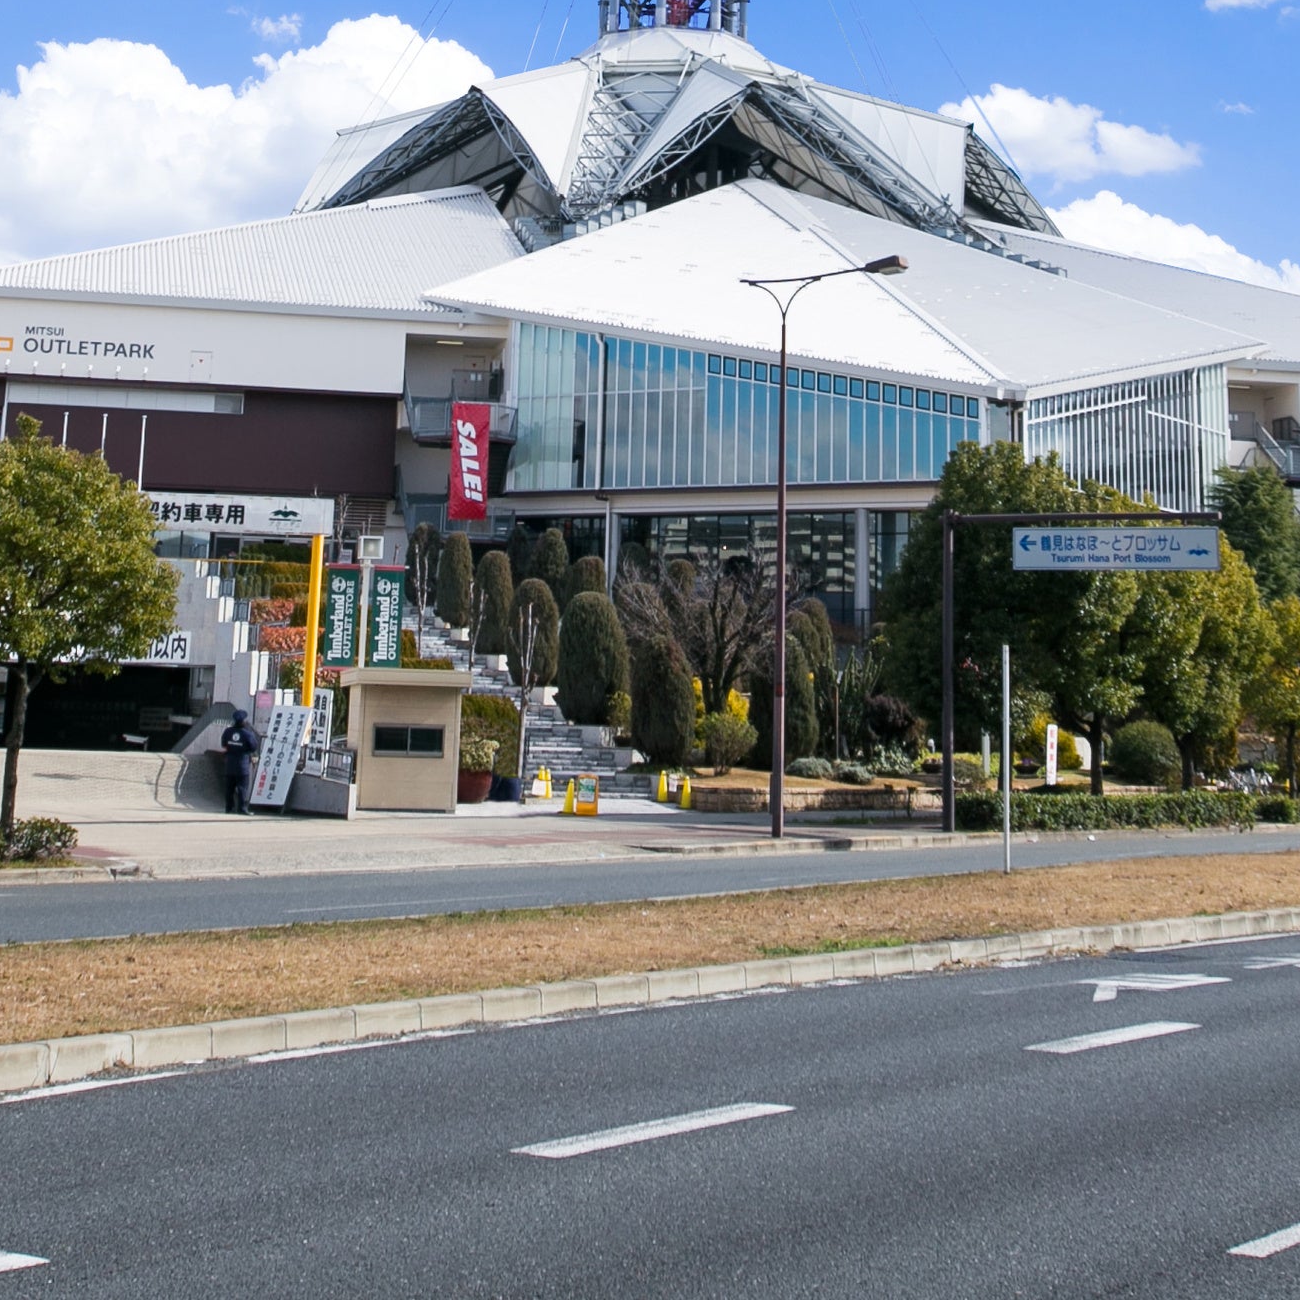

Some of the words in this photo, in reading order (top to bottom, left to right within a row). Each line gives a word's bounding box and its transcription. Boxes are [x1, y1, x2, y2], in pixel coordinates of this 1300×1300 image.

[24, 326, 65, 337] MITSUI
[457, 419, 484, 502] SALE!
[1051, 553, 1086, 563] Tsurumi
[1088, 553, 1110, 563] Hana
[1113, 553, 1132, 563] Port
[1134, 553, 1171, 563] Blossom
[345, 580, 355, 615] STORE
[390, 582, 400, 617] STORE
[327, 594, 345, 661] Timberland
[343, 615, 353, 659] OUTLET
[373, 596, 390, 663] Timberland
[388, 618, 398, 660] OUTLET
